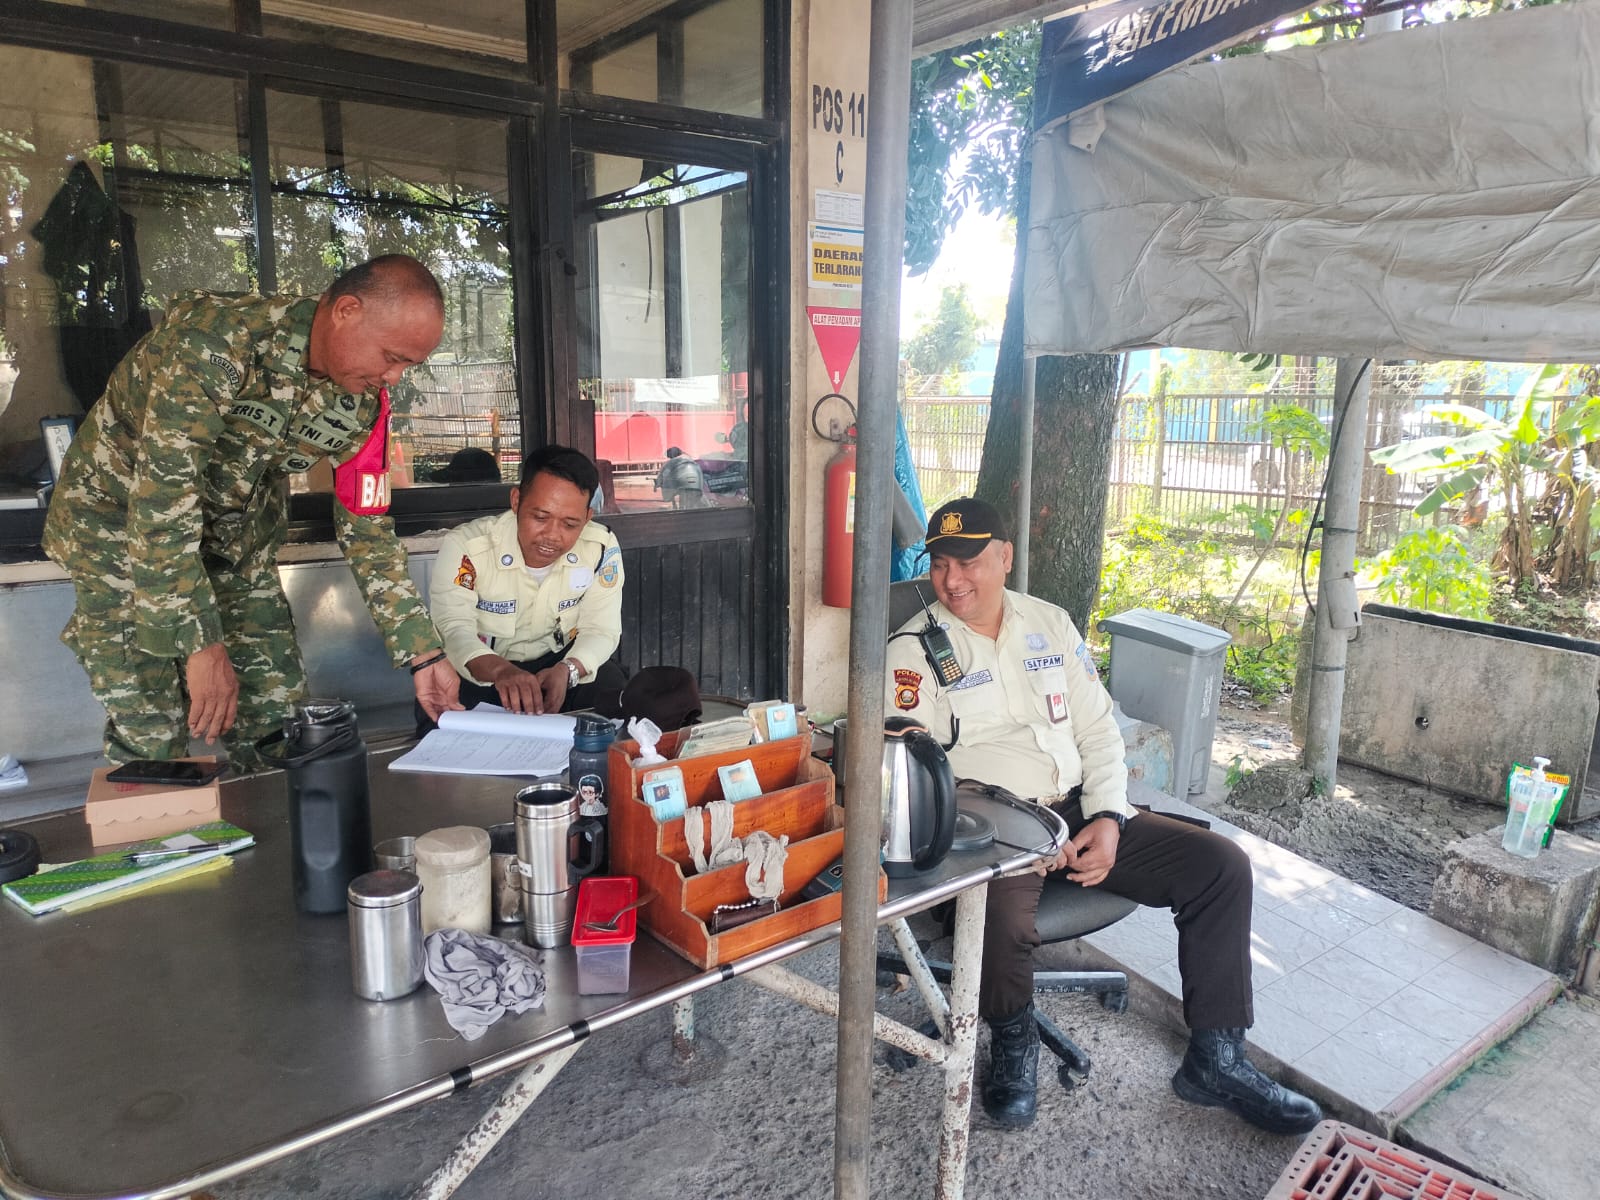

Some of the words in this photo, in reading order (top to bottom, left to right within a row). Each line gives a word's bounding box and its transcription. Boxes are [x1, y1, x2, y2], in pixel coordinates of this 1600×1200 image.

[812, 84, 843, 134] POS
[849, 92, 865, 138] 11
[836, 141, 844, 183] C
[814, 262, 862, 276] TERLARAN
[814, 314, 827, 324] ALAT
[213, 357, 238, 381] KOMANDO
[229, 404, 277, 427] ERIS.T
[298, 424, 322, 441] TNI
[324, 437, 344, 449] AD
[1027, 657, 1061, 669] SATPAM
